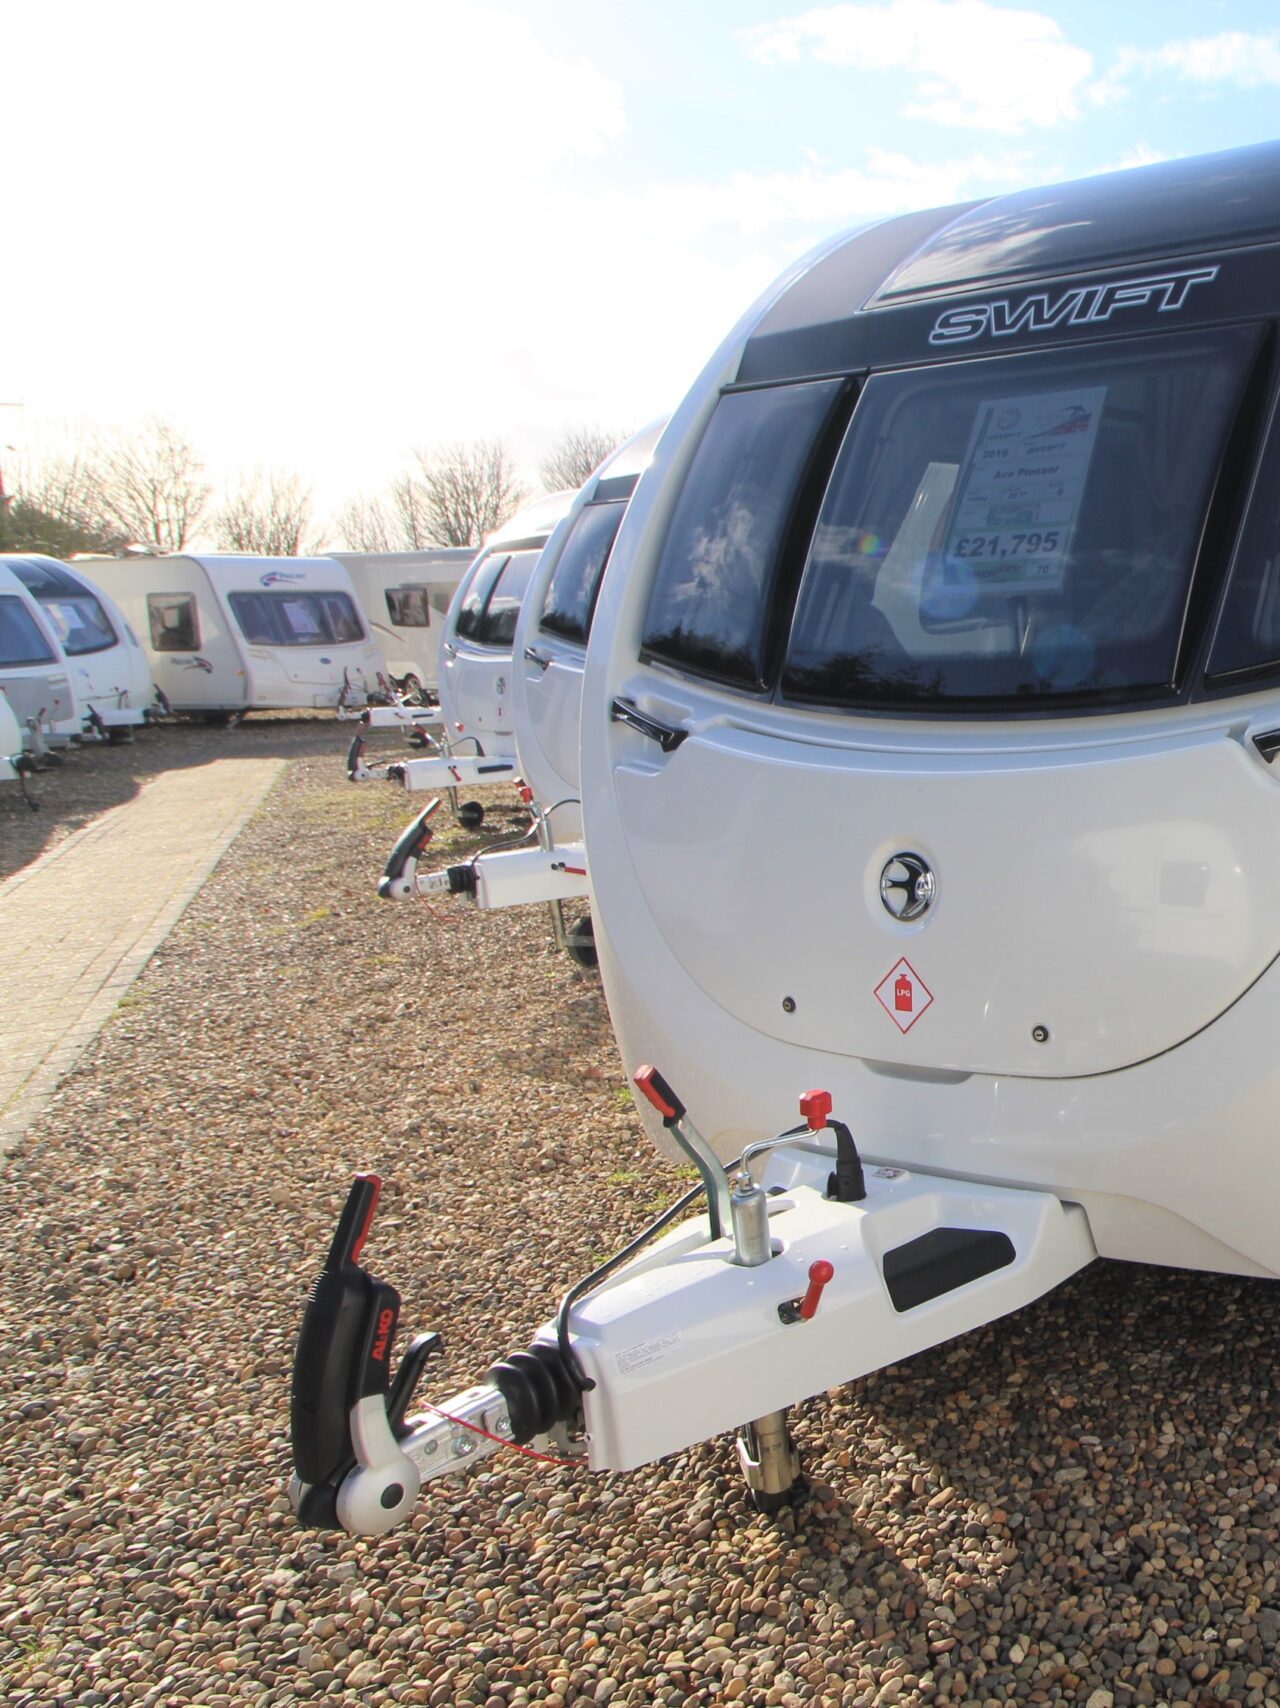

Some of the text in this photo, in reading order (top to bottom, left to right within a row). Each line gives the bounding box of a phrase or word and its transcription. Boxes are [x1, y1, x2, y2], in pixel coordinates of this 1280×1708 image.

[928, 265, 1221, 346] SWIFT
[993, 465, 1060, 480] Ace Pioneer
[954, 531, 1059, 559] £21,795
[897, 988, 911, 998] LPG
[371, 1308, 394, 1361] AL-KO
